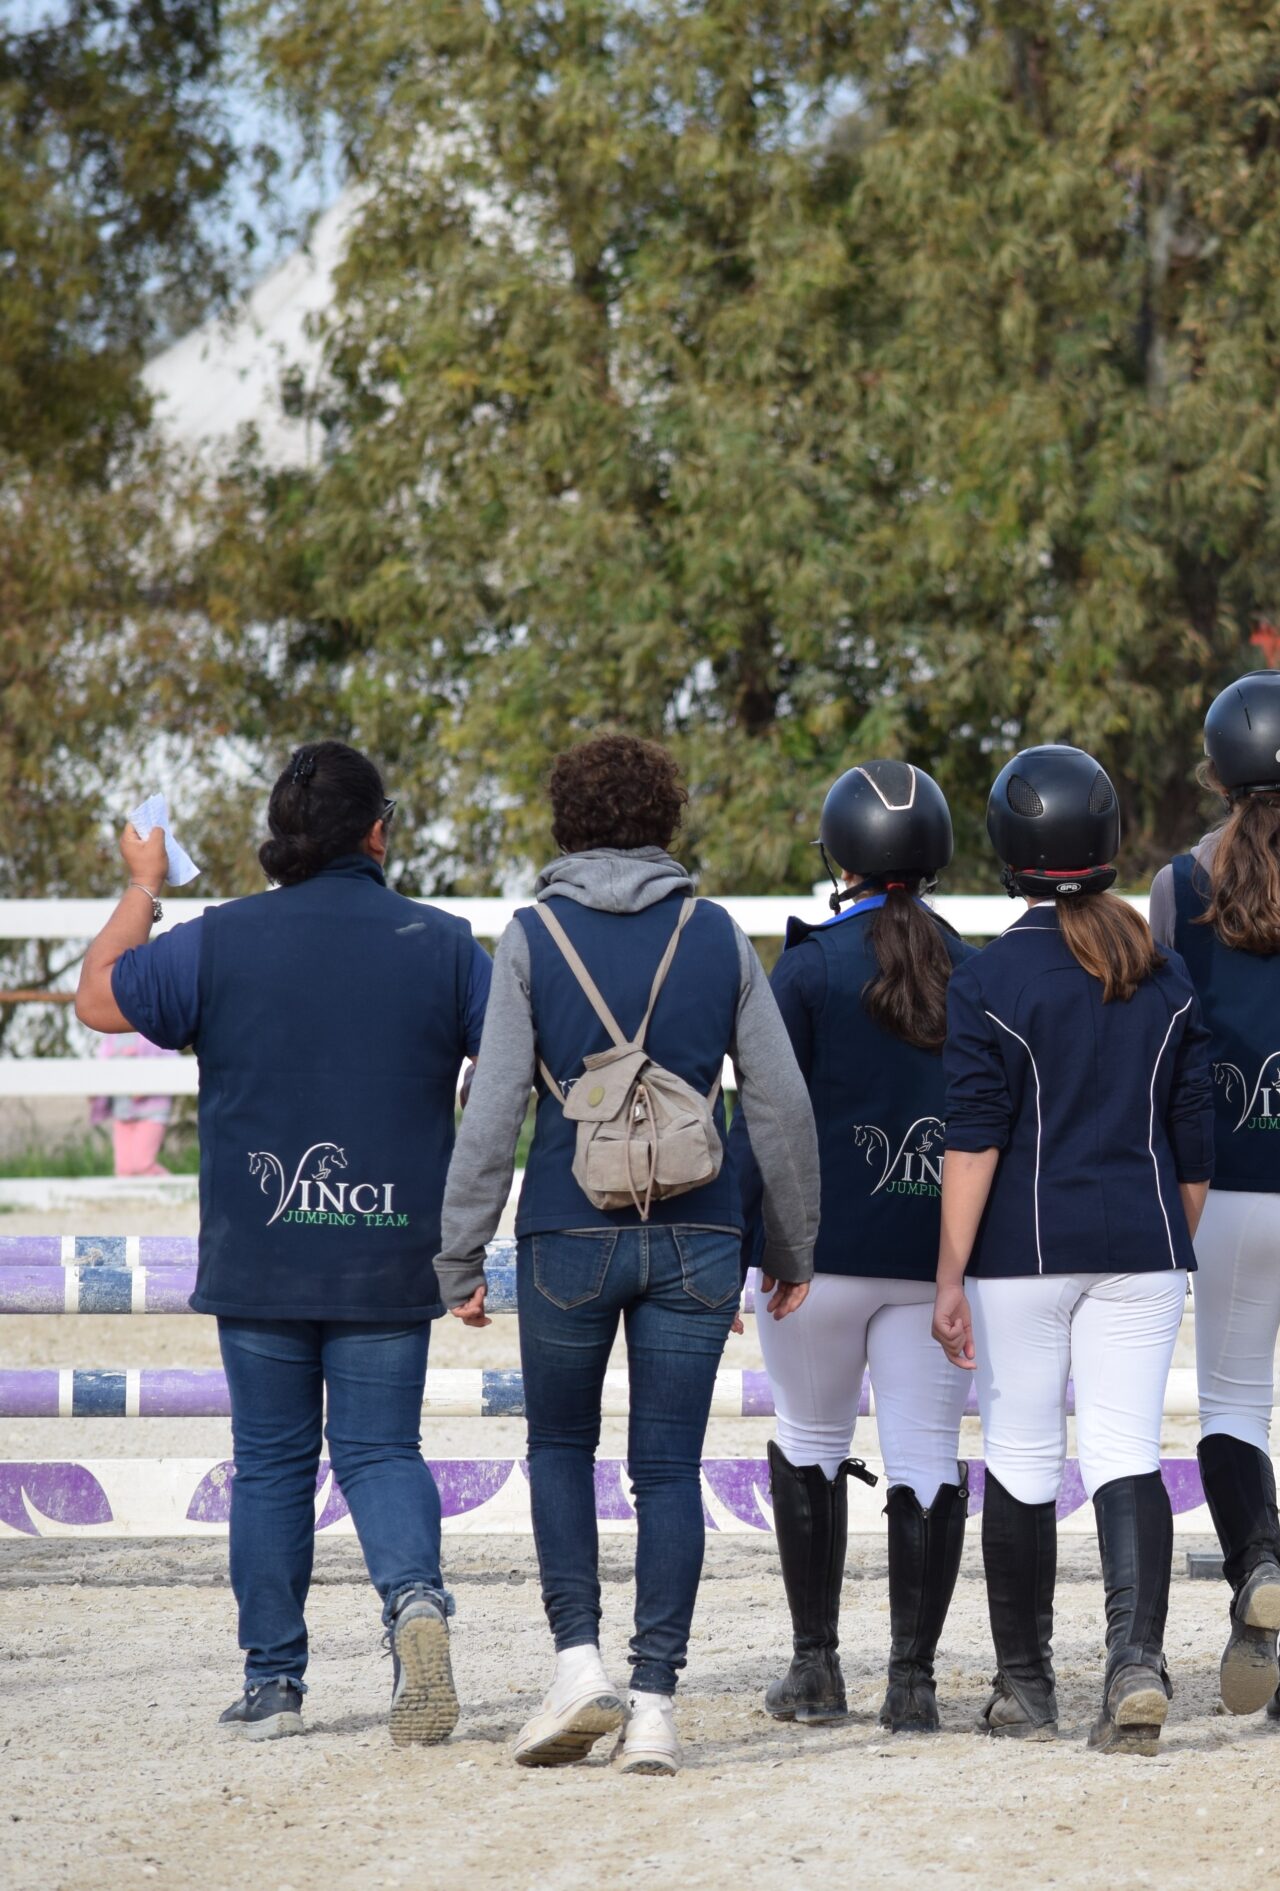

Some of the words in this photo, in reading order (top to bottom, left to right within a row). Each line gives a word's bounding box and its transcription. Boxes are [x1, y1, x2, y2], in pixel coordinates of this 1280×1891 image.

[853, 1117, 945, 1195] VIN
[248, 1143, 395, 1226] VINCI
[886, 1181, 942, 1197] JUMPIN
[283, 1210, 356, 1226] JUMPING
[363, 1213, 409, 1227] TEAM
